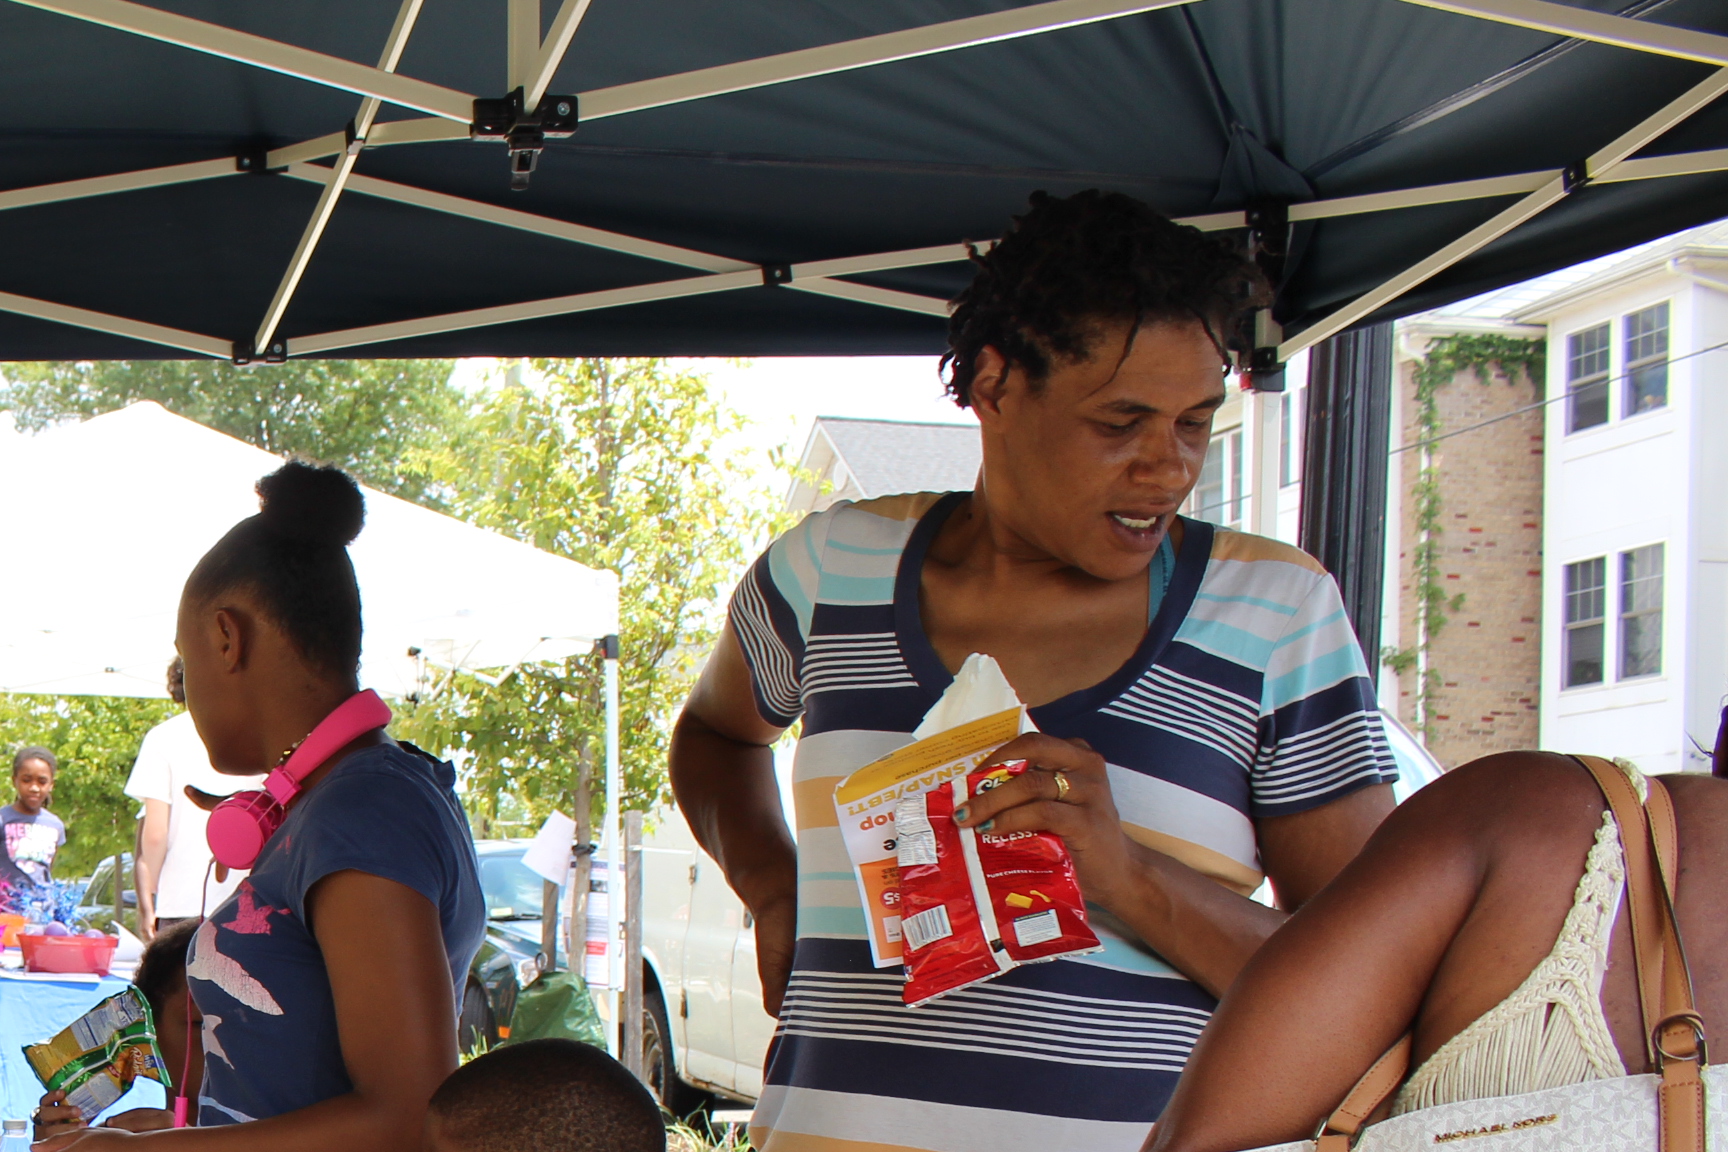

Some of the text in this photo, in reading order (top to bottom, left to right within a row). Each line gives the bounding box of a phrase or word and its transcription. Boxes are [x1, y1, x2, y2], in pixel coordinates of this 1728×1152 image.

[894, 759, 942, 780] purchase
[847, 761, 966, 817] SNAP/EBT!
[1433, 1114, 1559, 1144] MICHAEL KORS
